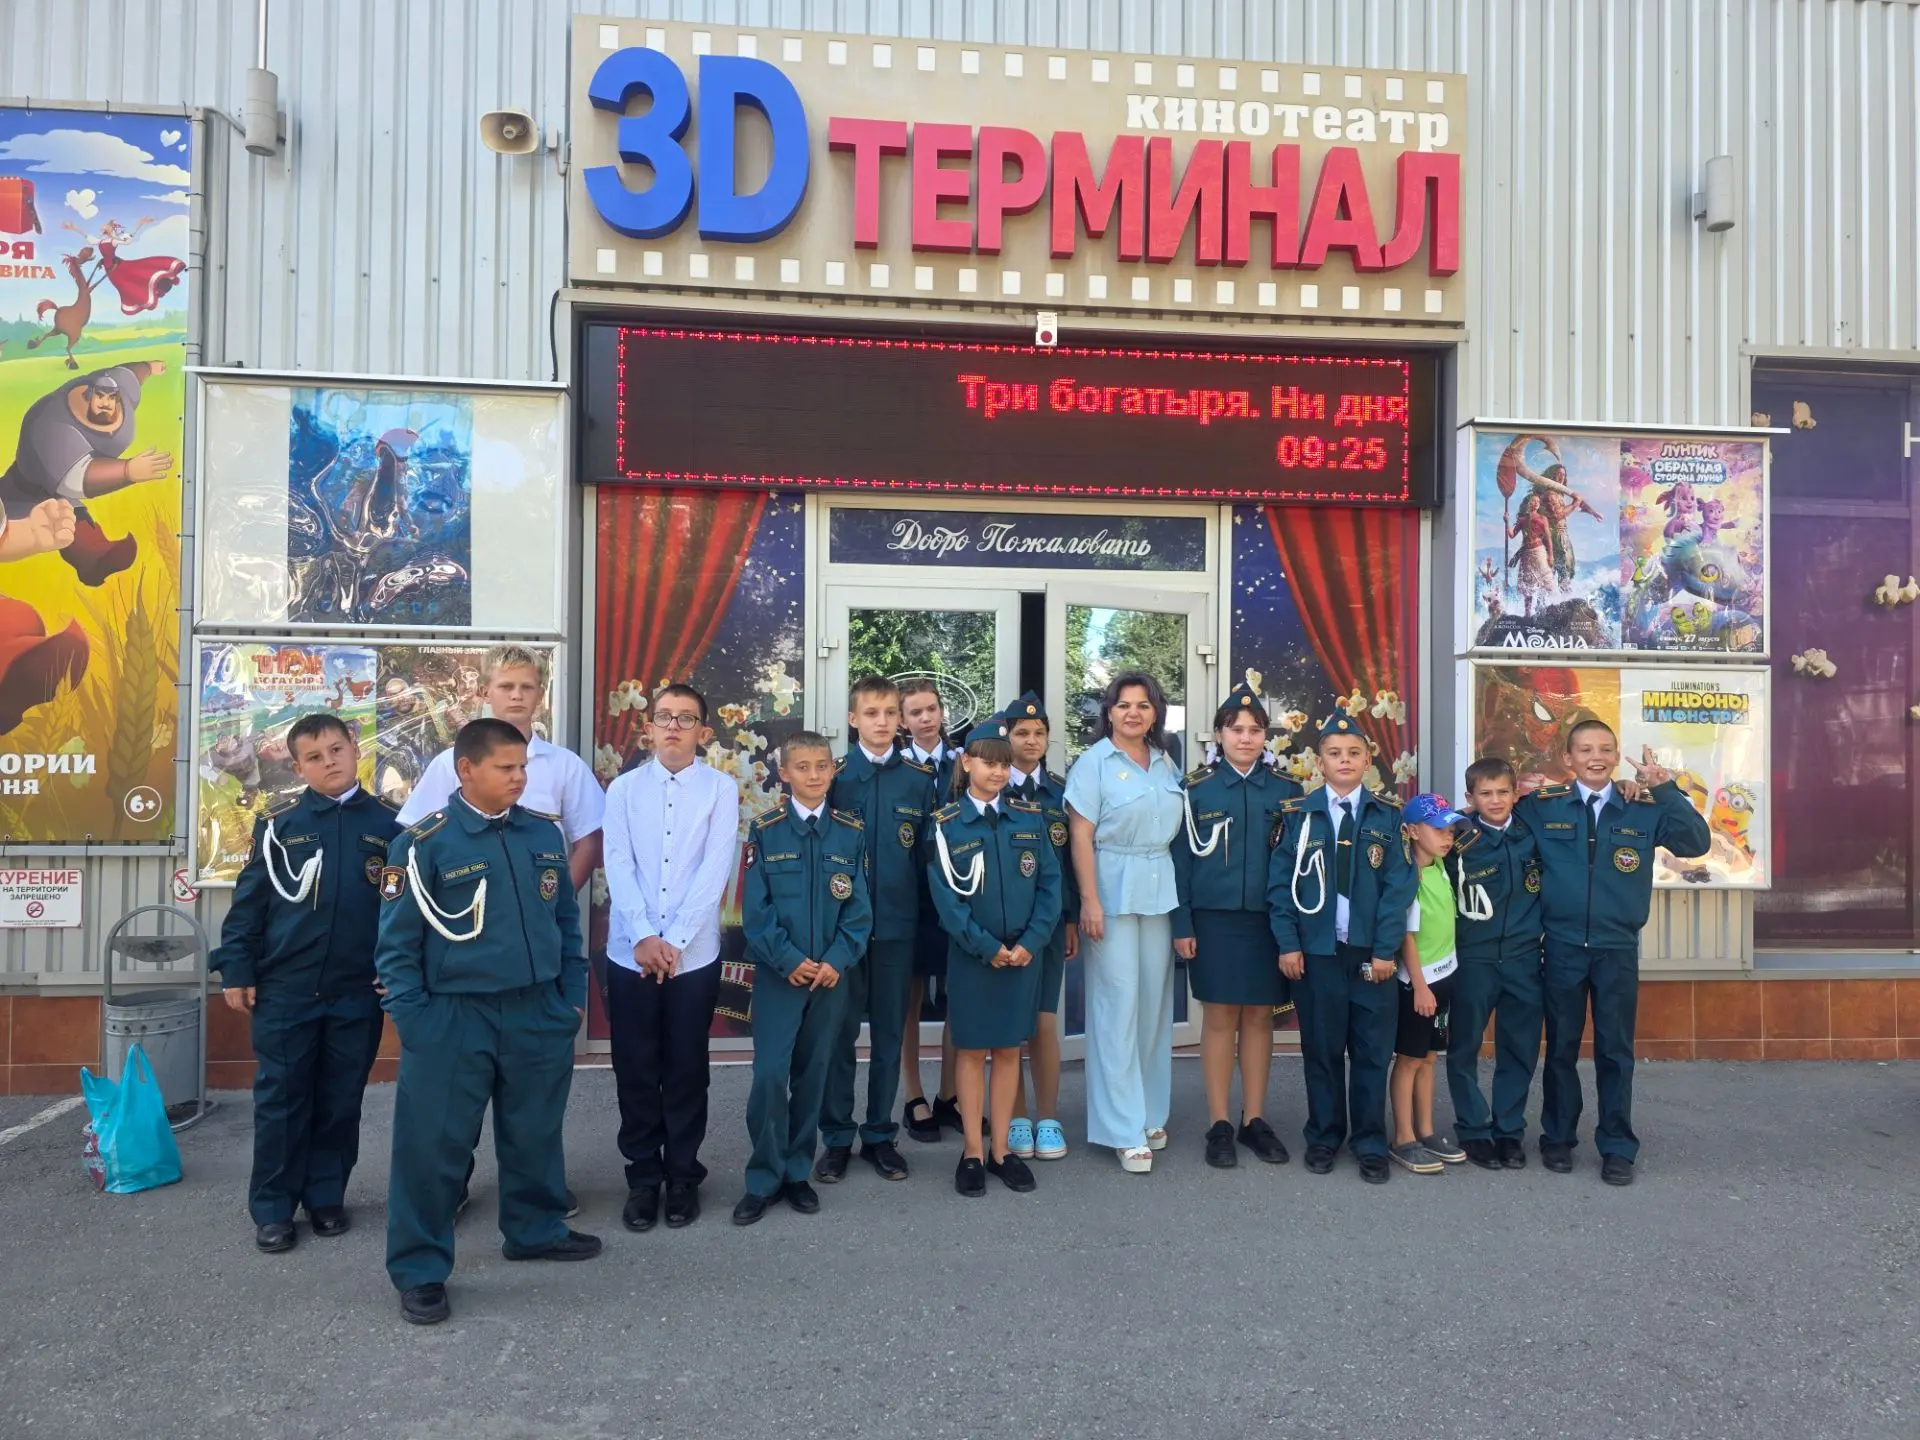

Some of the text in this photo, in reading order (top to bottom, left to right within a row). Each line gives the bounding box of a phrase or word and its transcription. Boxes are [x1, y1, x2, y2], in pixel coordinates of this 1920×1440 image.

[1126, 94, 1450, 152] кинотеатр
[584, 47, 810, 243] 3D
[828, 117, 1461, 277] ТЕРМИНАЛ
[958, 373, 1406, 428] Три богатыря. Ни дня
[1276, 435, 1388, 471] 09:25
[1661, 443, 1719, 459] ЛУНТИК
[1654, 460, 1723, 473] ОБРАТНАЯ
[1653, 473, 1695, 482] СТОРОНА
[887, 518, 1152, 558] Добро Пожаловать
[1684, 634, 1696, 643] 27
[1671, 681, 1720, 691] ILLUMINATION'S
[1642, 691, 1749, 711] МИНЬОНЫ
[0, 779, 40, 795] НЯ
[130, 795, 155, 813] 6+
